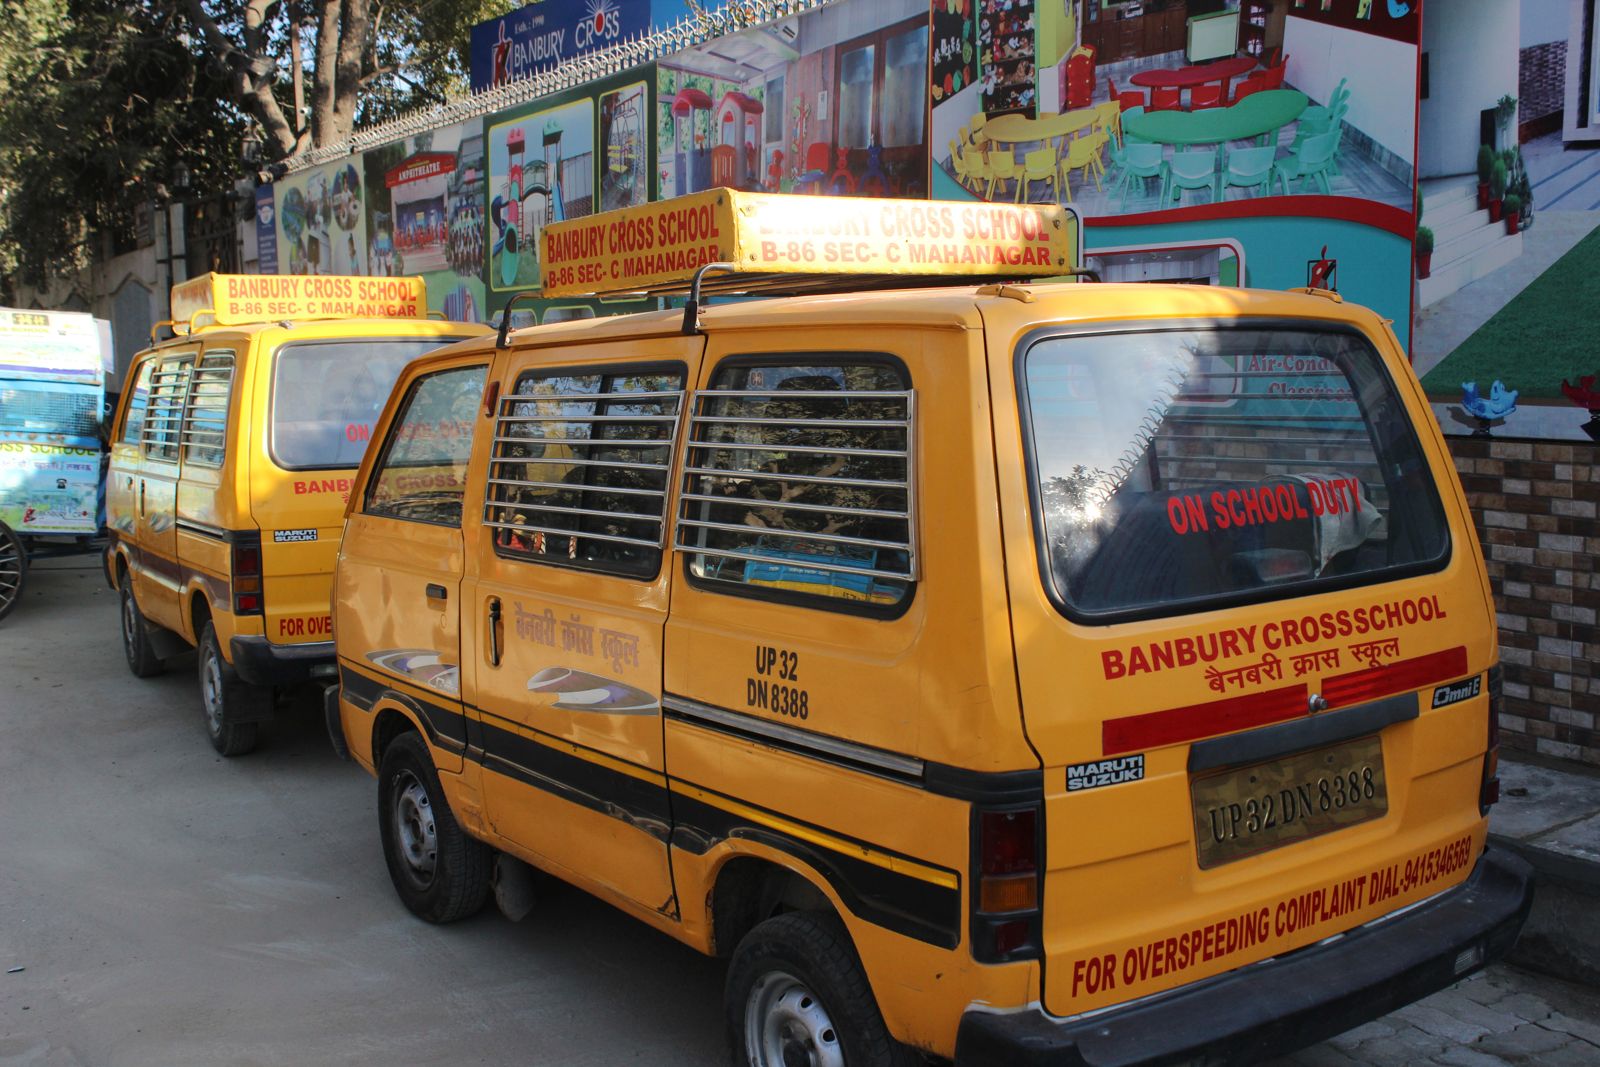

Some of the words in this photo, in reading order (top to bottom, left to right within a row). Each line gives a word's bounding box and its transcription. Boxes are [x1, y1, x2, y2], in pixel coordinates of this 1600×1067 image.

[514, 29, 565, 67] BANBURY
[575, 11, 620, 48] CROSS
[399, 161, 441, 181] AMPHITHEATRE
[547, 224, 606, 264] BANBURY
[609, 216, 654, 254] CROSS
[658, 203, 719, 249] SCHOOL
[880, 206, 955, 239] CROSS
[962, 206, 1050, 241] SCHOOL
[761, 241, 816, 262] B-86
[886, 242, 900, 262] C
[909, 244, 1051, 266] MAHANAGAR
[549, 267, 574, 289] B-86
[611, 260, 620, 279] C
[623, 244, 719, 277] MAHANAGAR
[229, 278, 299, 299] BANBURY
[304, 278, 353, 299] CROSS
[358, 281, 417, 302] SCHOOL
[230, 302, 263, 315] B-86
[307, 302, 316, 314] C
[321, 302, 417, 317] MAHANAGAR
[1248, 352, 1329, 372] Air-Cond
[345, 423, 369, 441] ON
[294, 479, 355, 494] BANB
[1167, 494, 1209, 535] ON
[1210, 483, 1309, 529] SCHOOL
[1305, 476, 1364, 516] DUTY
[275, 529, 317, 537] MARUTI
[280, 617, 304, 636] FOR
[308, 616, 332, 635] OVE
[1100, 625, 1257, 681] BANBURY
[1204, 653, 1283, 693] बैनबरी
[1290, 647, 1340, 677] क्रास
[1348, 636, 1400, 667] स्कूल
[1067, 755, 1143, 778] MARUTI
[1067, 767, 1143, 790] SUZUKI
[1071, 954, 1116, 998] FOR
[1122, 907, 1270, 986] OVERSPEEDING
[1275, 876, 1367, 938] COMPLAINT
